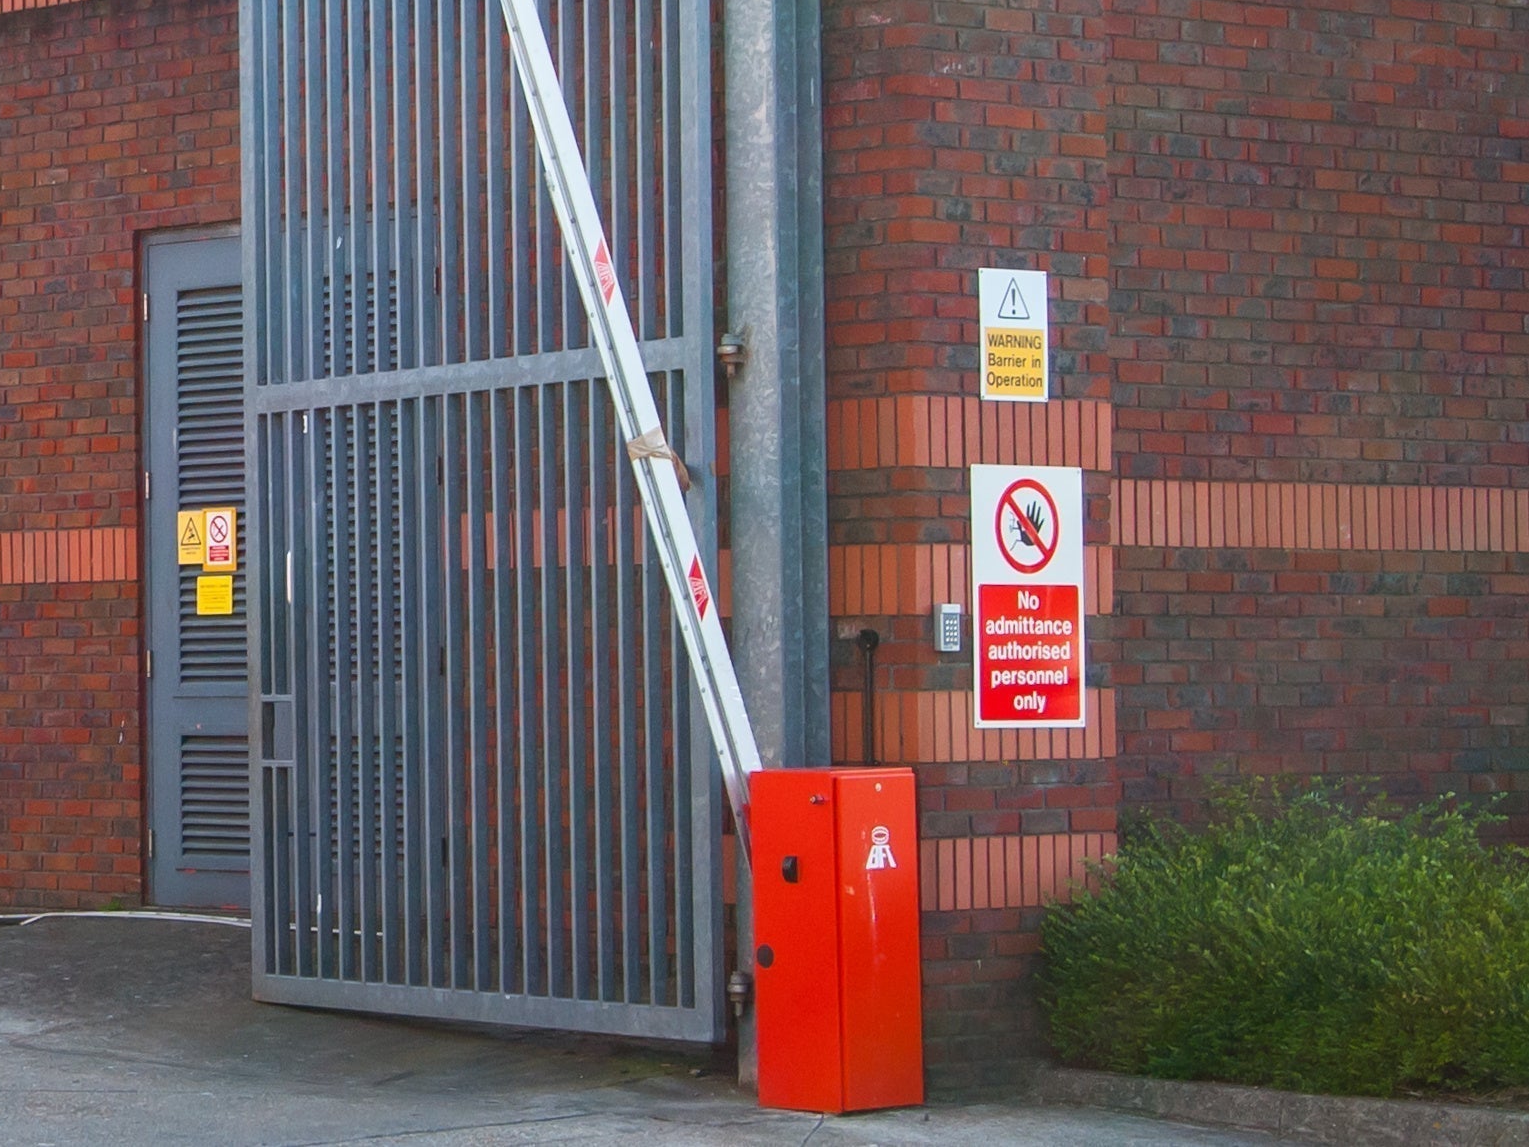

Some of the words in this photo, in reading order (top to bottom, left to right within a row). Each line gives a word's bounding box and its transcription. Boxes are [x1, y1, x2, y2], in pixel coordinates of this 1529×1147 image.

[987, 333, 1042, 350] WARNING
[988, 352, 1027, 368] Barrier
[1031, 354, 1042, 369] in
[986, 371, 1043, 388] Operation
[1017, 591, 1040, 610] No
[985, 616, 1073, 635] admittance
[987, 642, 1071, 661] authorised
[990, 666, 1069, 689] personnel
[1013, 692, 1047, 714] only
